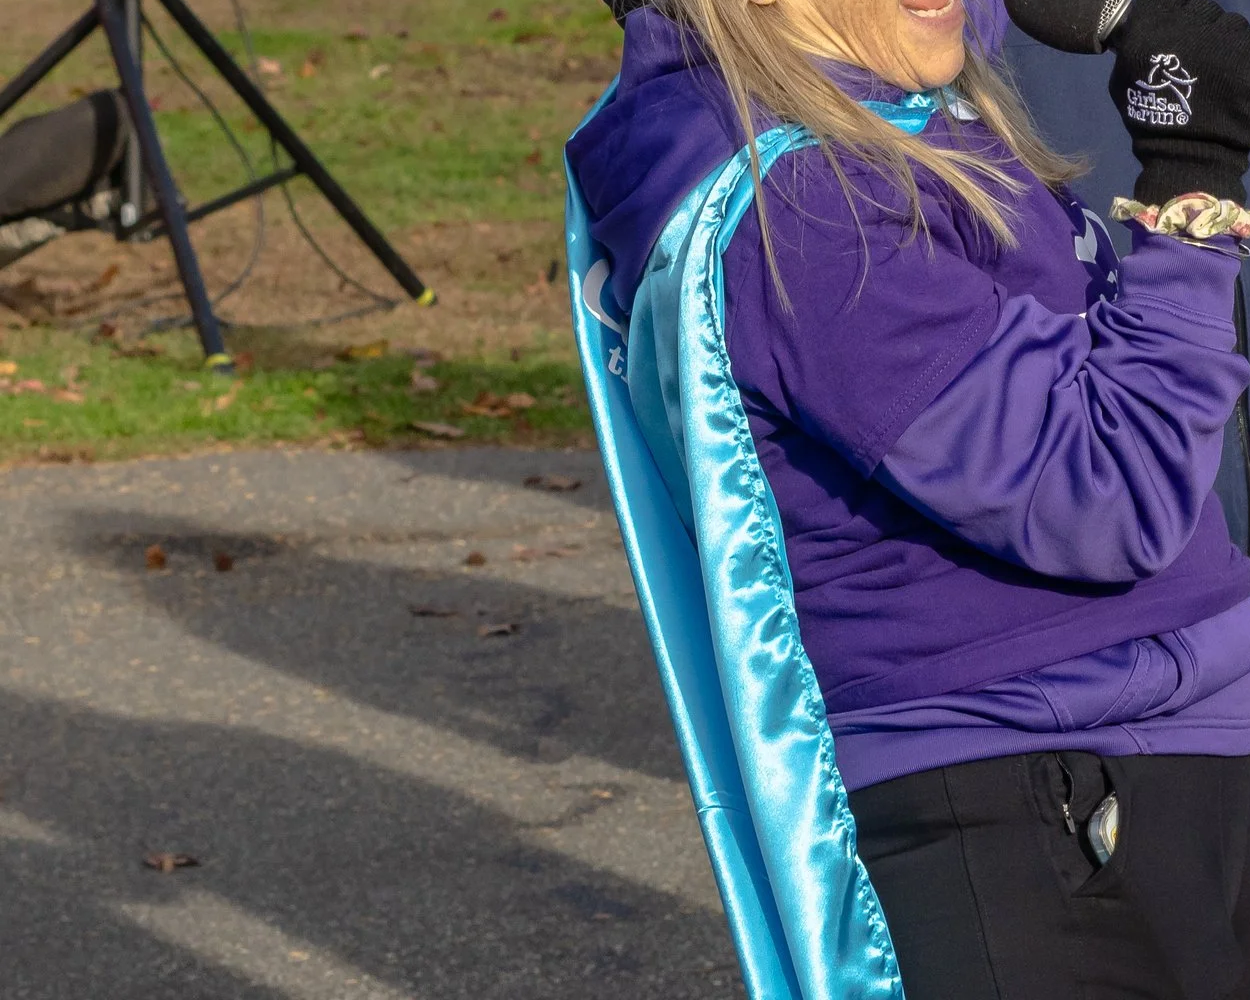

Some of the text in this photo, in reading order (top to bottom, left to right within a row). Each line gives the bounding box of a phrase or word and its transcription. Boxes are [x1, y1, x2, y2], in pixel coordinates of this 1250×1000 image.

[1127, 88, 1182, 112] Girls on
[1127, 105, 1141, 120] the
